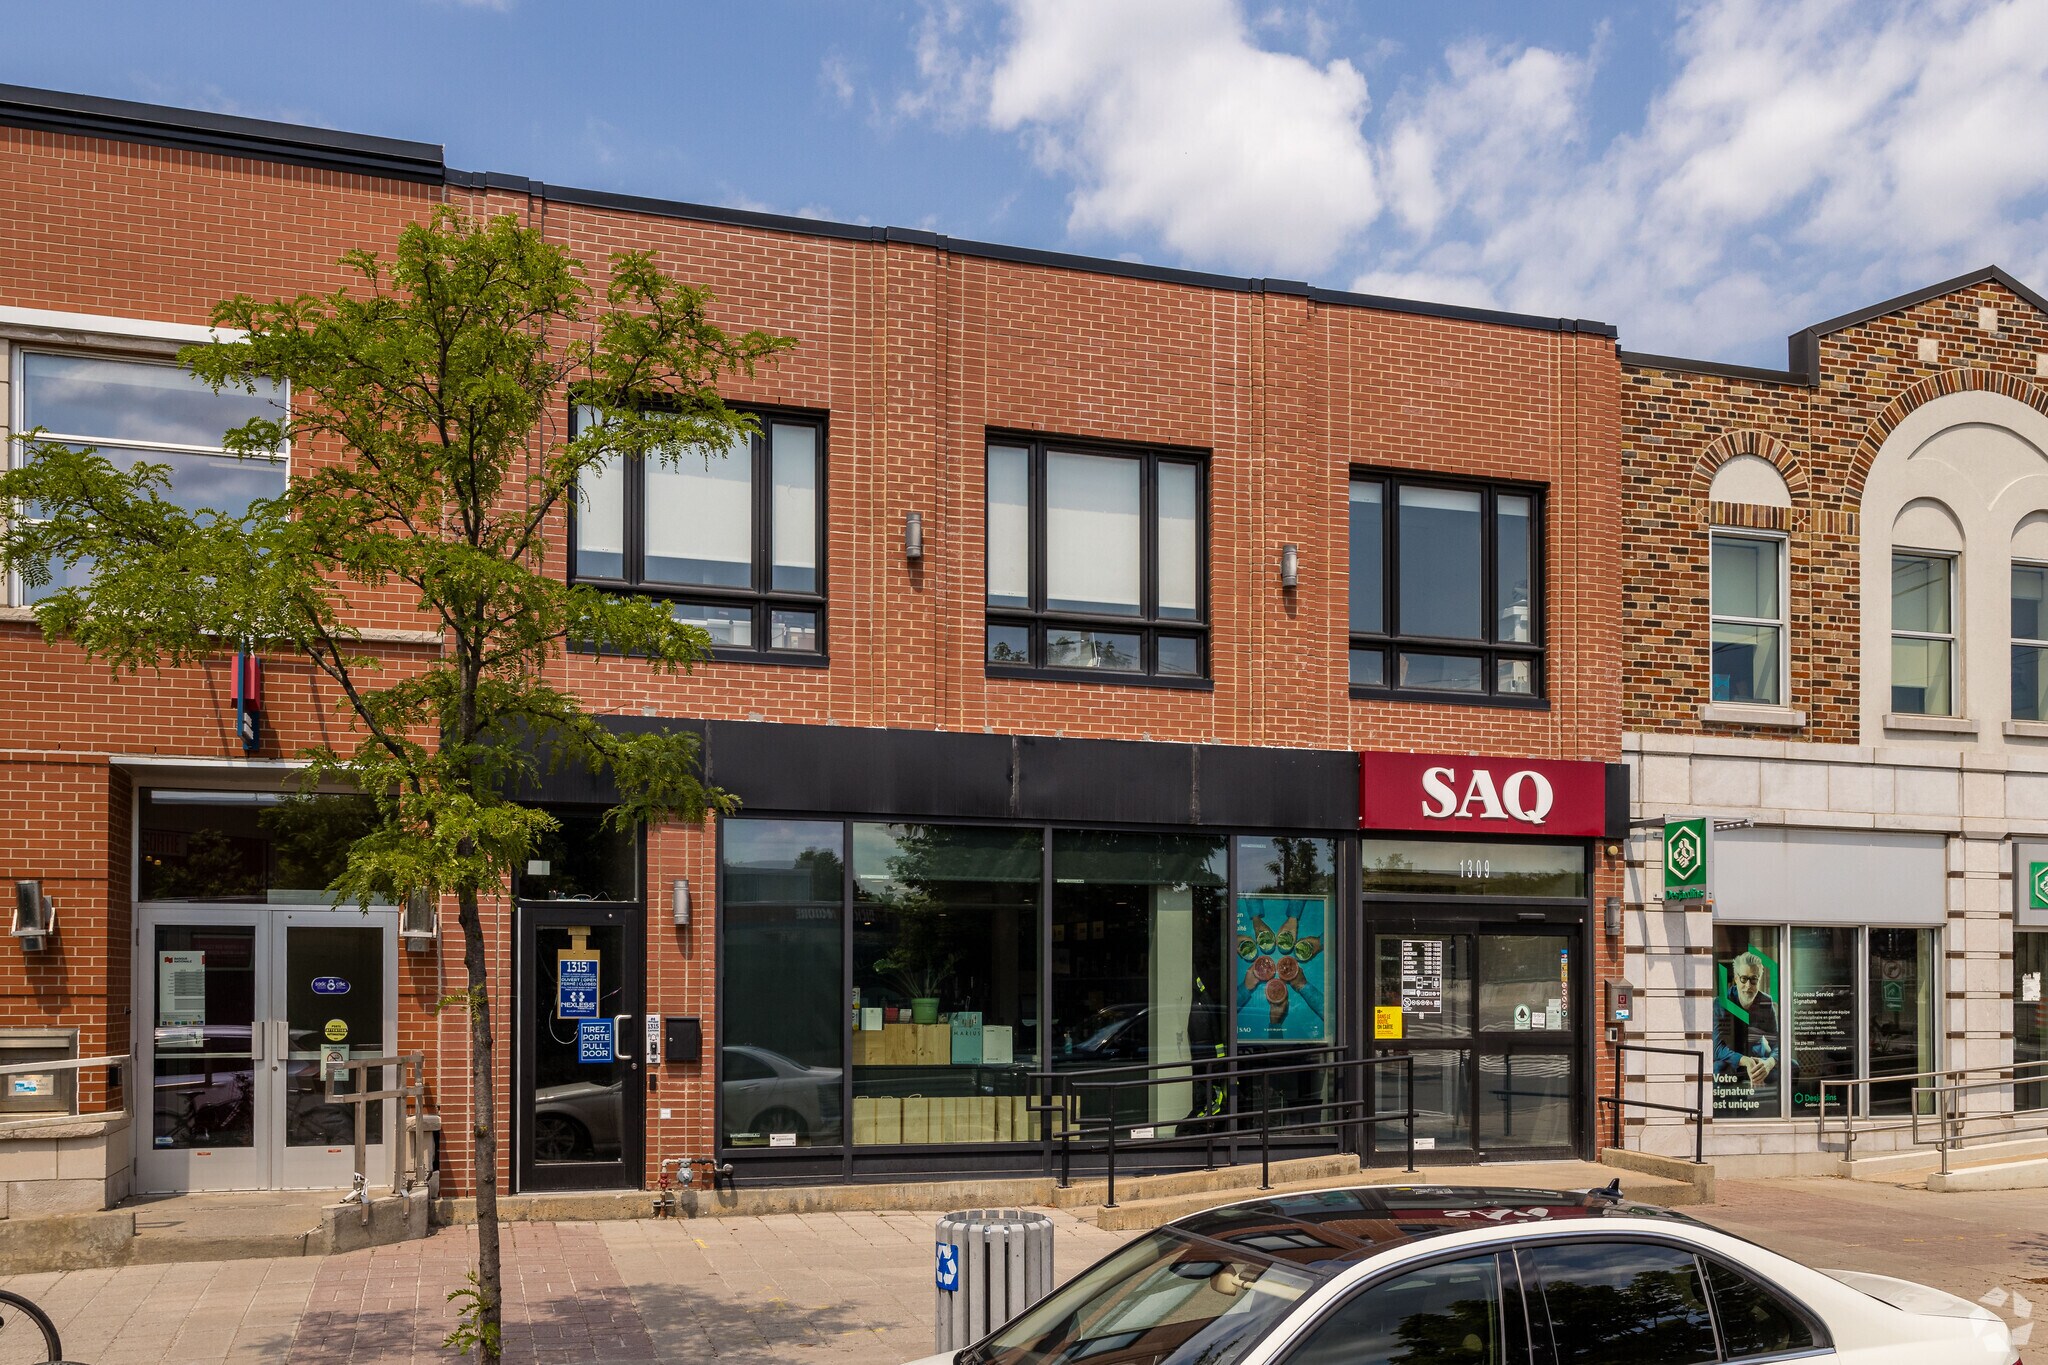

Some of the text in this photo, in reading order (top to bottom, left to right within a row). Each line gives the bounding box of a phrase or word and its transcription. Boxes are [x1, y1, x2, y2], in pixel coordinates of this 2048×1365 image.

[1422, 766, 1554, 825] SAQ
[1459, 859, 1490, 878] 1309
[1665, 887, 1704, 902] Desjardins
[566, 961, 587, 973] 1315
[582, 1033, 610, 1041] PORTE
[1713, 1073, 1738, 1083] Votre
[1713, 1086, 1755, 1098] signature
[1713, 1098, 1760, 1111] est unique
